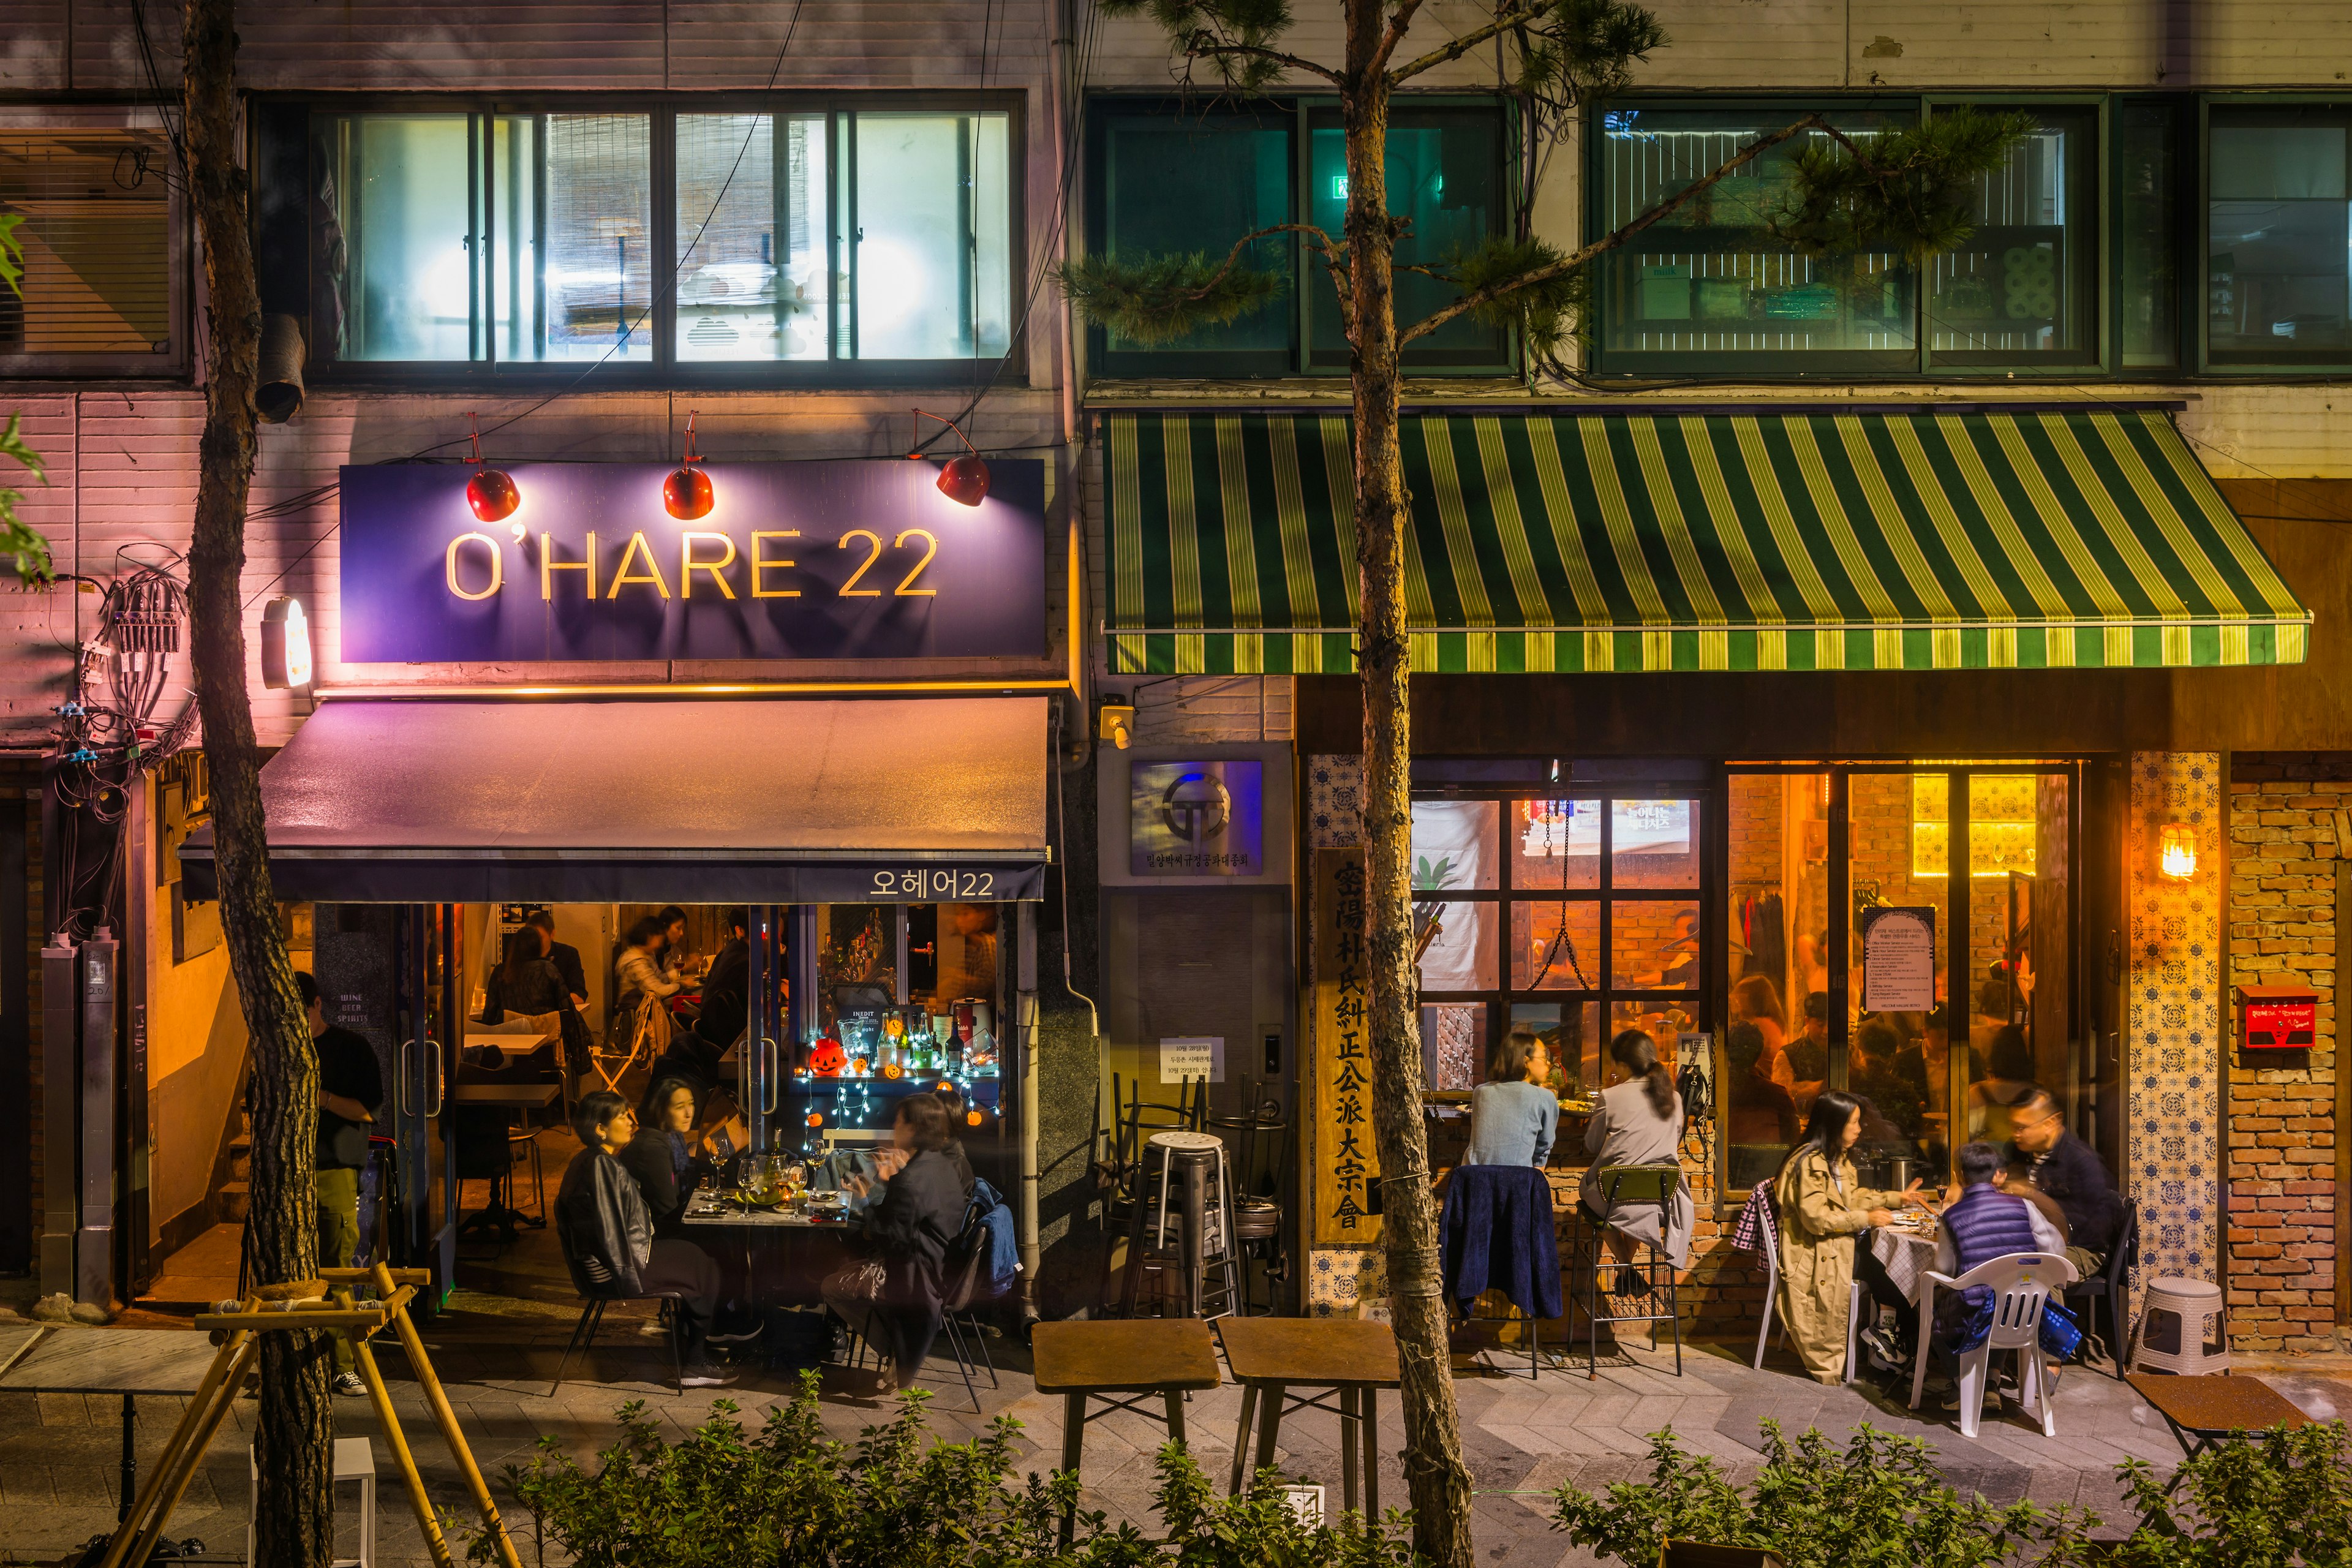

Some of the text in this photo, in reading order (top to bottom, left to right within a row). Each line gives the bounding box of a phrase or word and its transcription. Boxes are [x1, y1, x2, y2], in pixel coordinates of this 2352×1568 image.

[445, 522, 938, 601] O'HARE 22
[1627, 807, 1670, 819] 늘어나는
[1147, 853, 1248, 868] 밀양박씨규정공파대종회
[870, 869, 993, 899] 오헤어22
